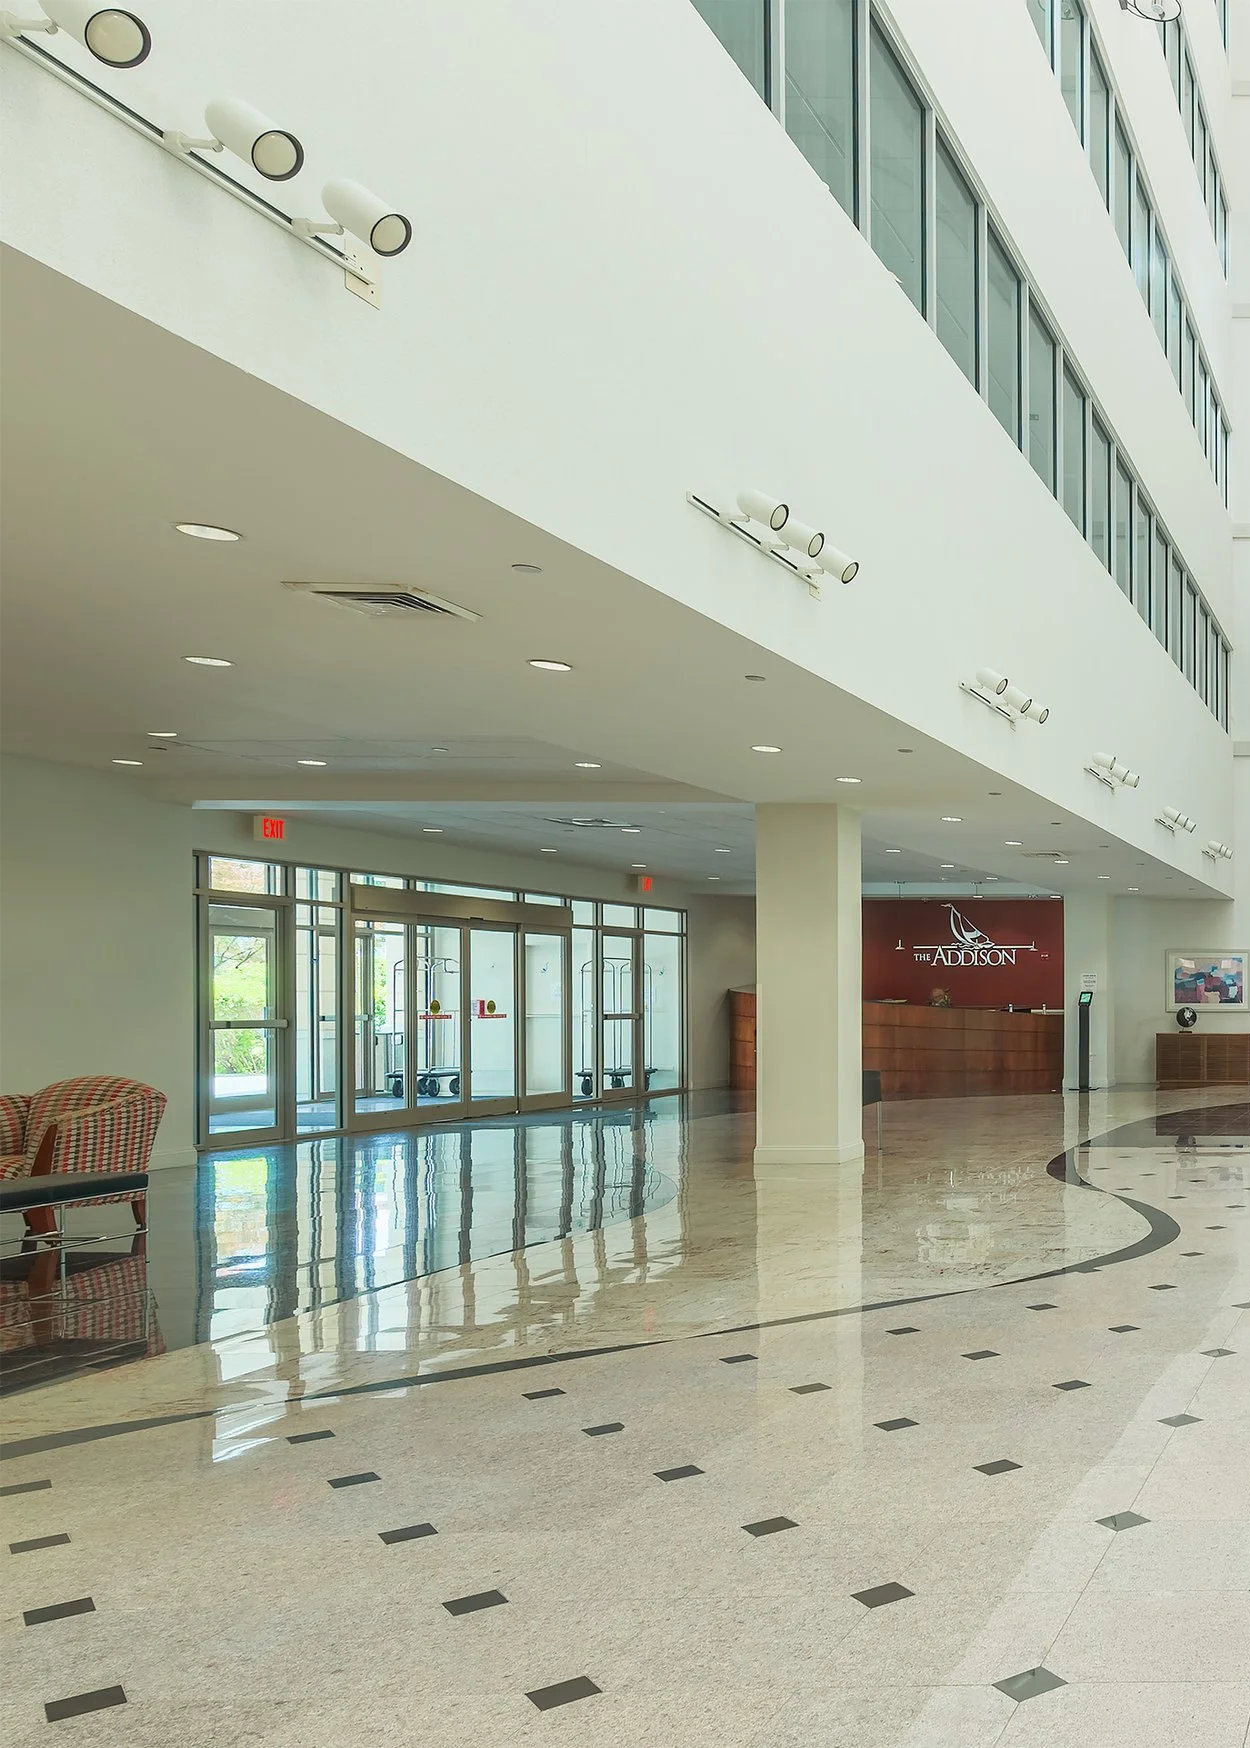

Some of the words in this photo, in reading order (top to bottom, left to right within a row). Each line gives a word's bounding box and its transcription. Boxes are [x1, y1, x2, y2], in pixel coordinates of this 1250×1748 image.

[263, 818, 284, 839] EXIT
[914, 953, 931, 961] THE
[930, 945, 1017, 966] ADDISON
